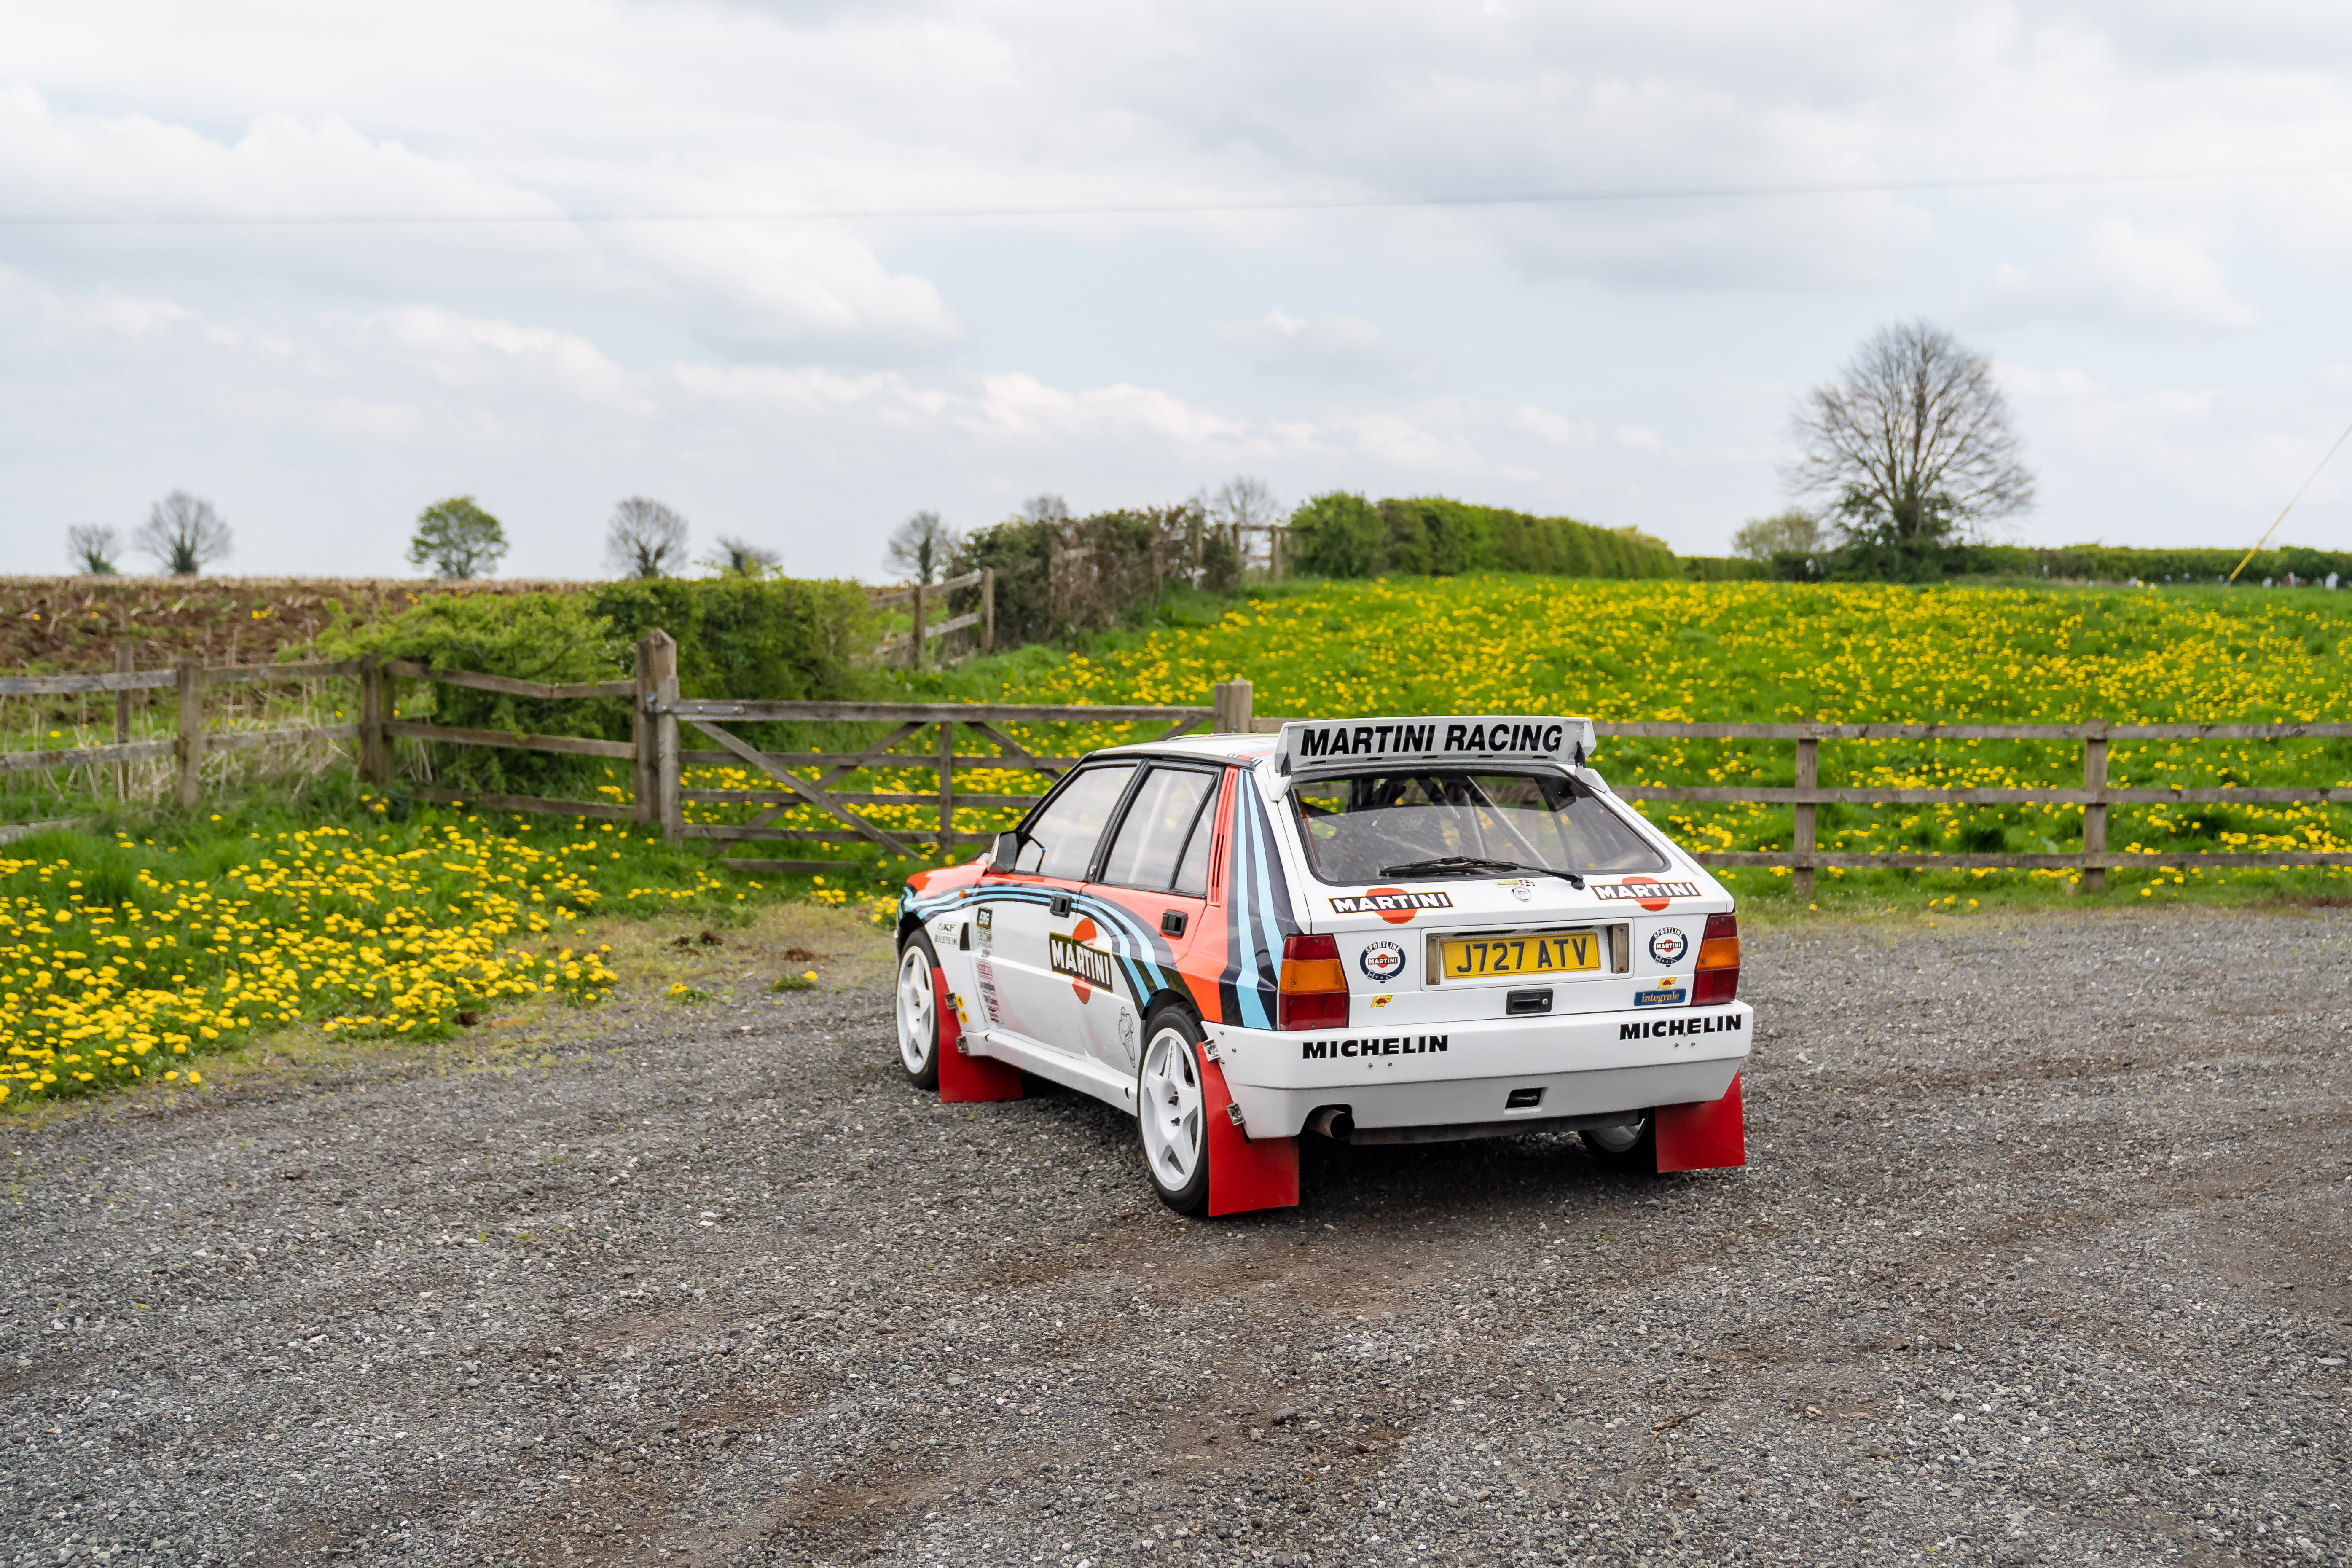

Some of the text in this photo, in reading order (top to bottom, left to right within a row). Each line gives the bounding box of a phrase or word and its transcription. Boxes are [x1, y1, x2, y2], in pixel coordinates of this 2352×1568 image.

[1300, 724, 1563, 756] MARTINI RACING
[1595, 883, 1698, 899] MARTINI
[1333, 892, 1451, 912] MARTINI
[938, 922, 956, 932] SKF
[1653, 927, 1684, 939] SPORTLINE
[934, 934, 957, 945] BILSTEIN
[1365, 942, 1401, 953] SPORTLINE
[1051, 939, 1111, 985] MARTINI
[1456, 937, 1587, 973] J727 ATV
[1641, 991, 1680, 1003] integrale
[1619, 1014, 1742, 1041] MICHELIN
[1302, 1034, 1449, 1059] MICHELIN
